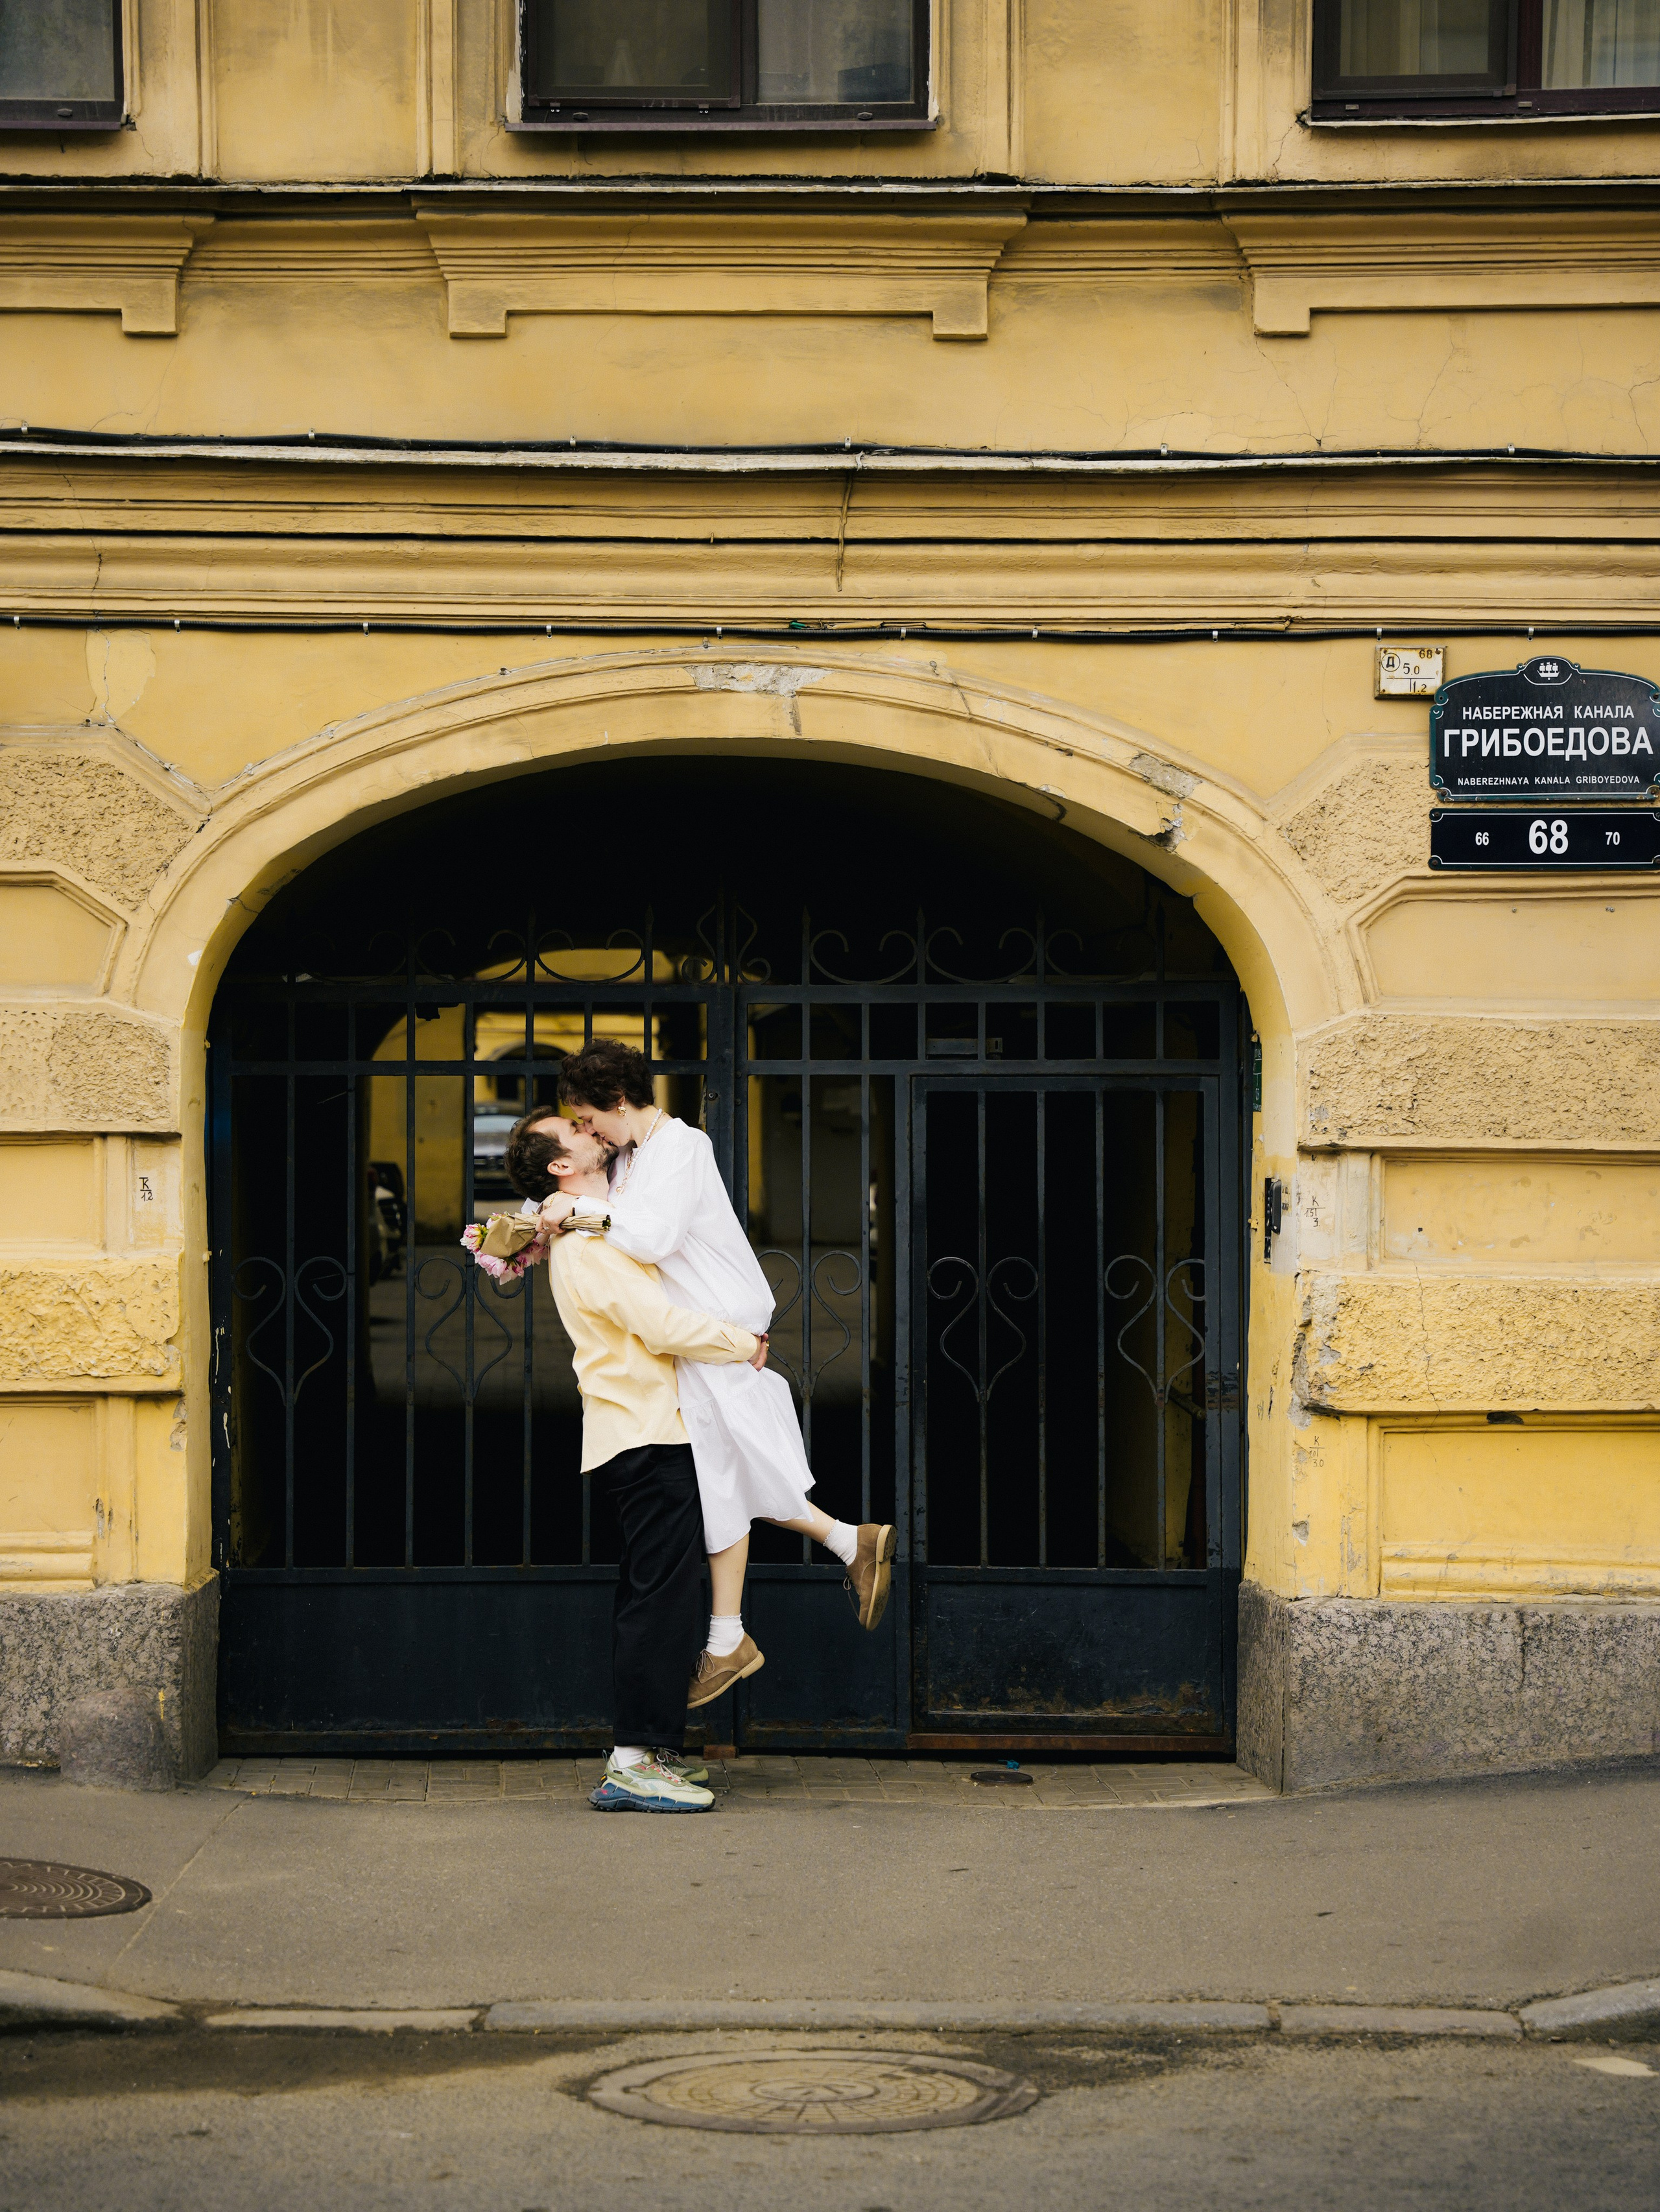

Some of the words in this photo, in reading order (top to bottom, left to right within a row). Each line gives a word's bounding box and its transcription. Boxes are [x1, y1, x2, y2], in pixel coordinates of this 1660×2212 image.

[1419, 649, 1432, 659] 68
[1386, 656, 1395, 669] Д
[1462, 706, 1563, 720] НАБЕРЕЖНАЯ
[1574, 705, 1635, 719] КАНАЛА
[1443, 726, 1654, 761] ГРИБОЕДОВА
[1458, 778, 1530, 786] NABEREZHNAYA
[1534, 776, 1571, 785] KANALA
[1576, 776, 1640, 784] GRIBOYEDOVA
[1475, 831, 1489, 846] 66
[1528, 820, 1569, 855] 68
[1605, 831, 1620, 846] 70
